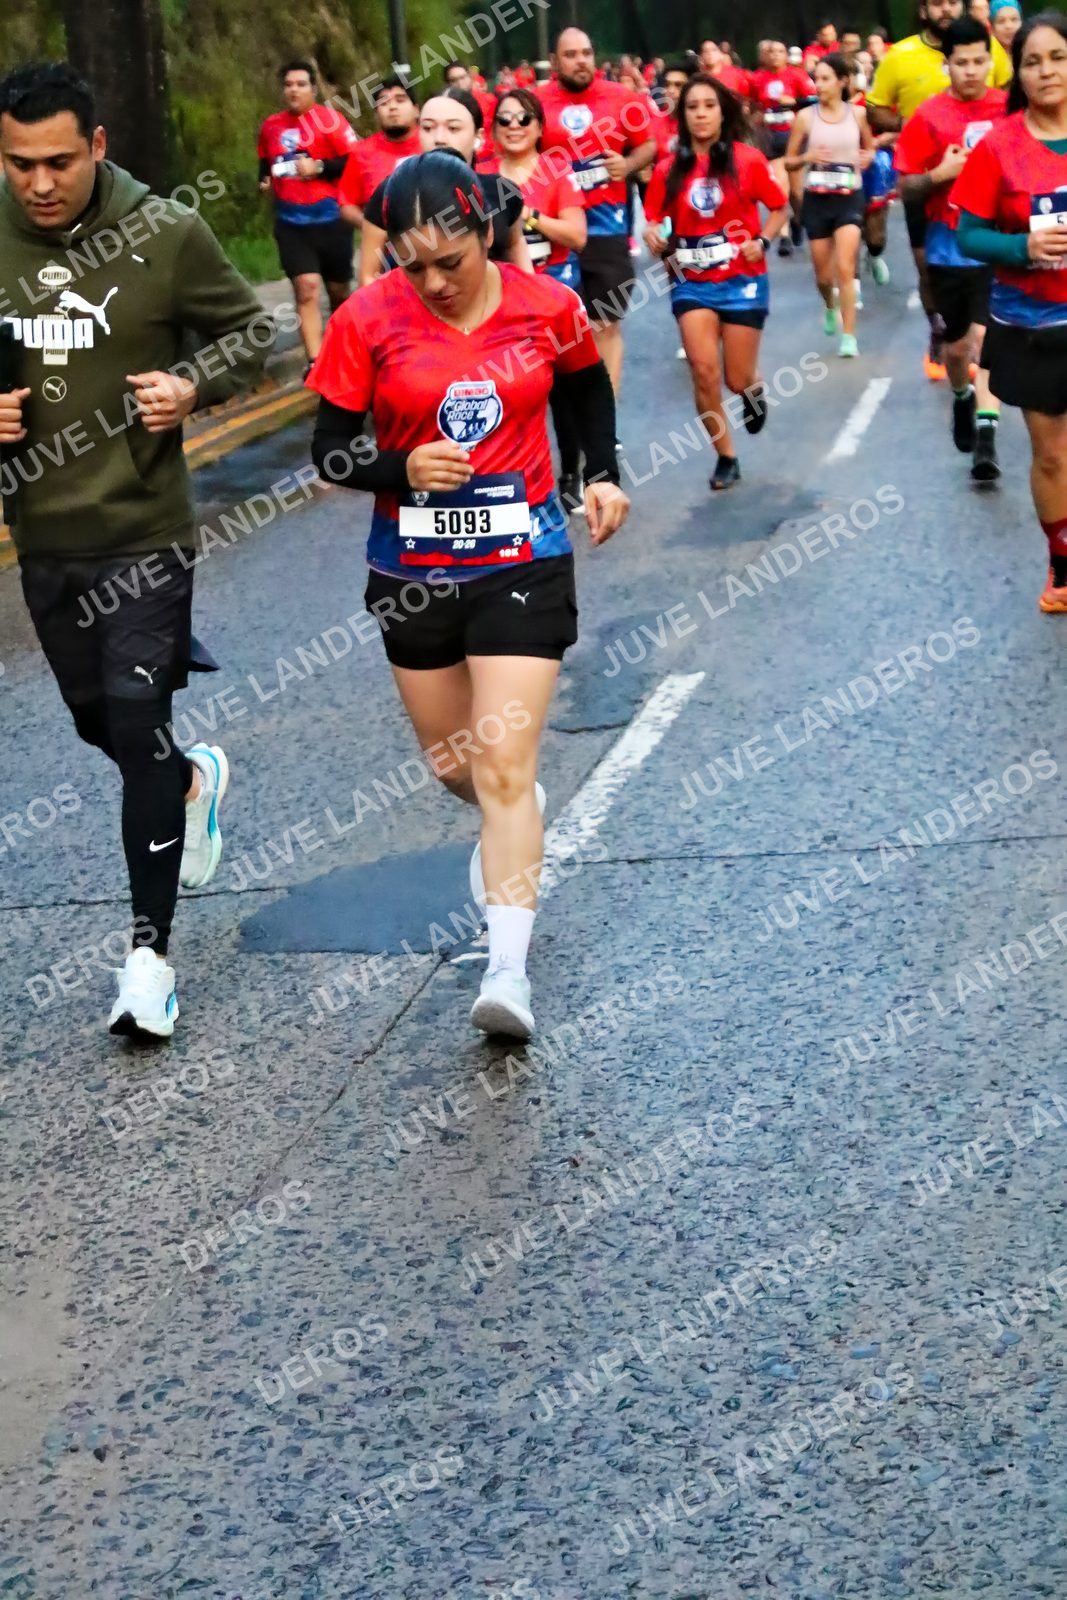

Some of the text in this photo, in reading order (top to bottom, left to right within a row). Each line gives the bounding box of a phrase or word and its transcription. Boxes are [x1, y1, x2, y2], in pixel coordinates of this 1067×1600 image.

[455, 400, 488, 411] Global
[447, 410, 474, 421] Race
[434, 509, 491, 535] 5093
